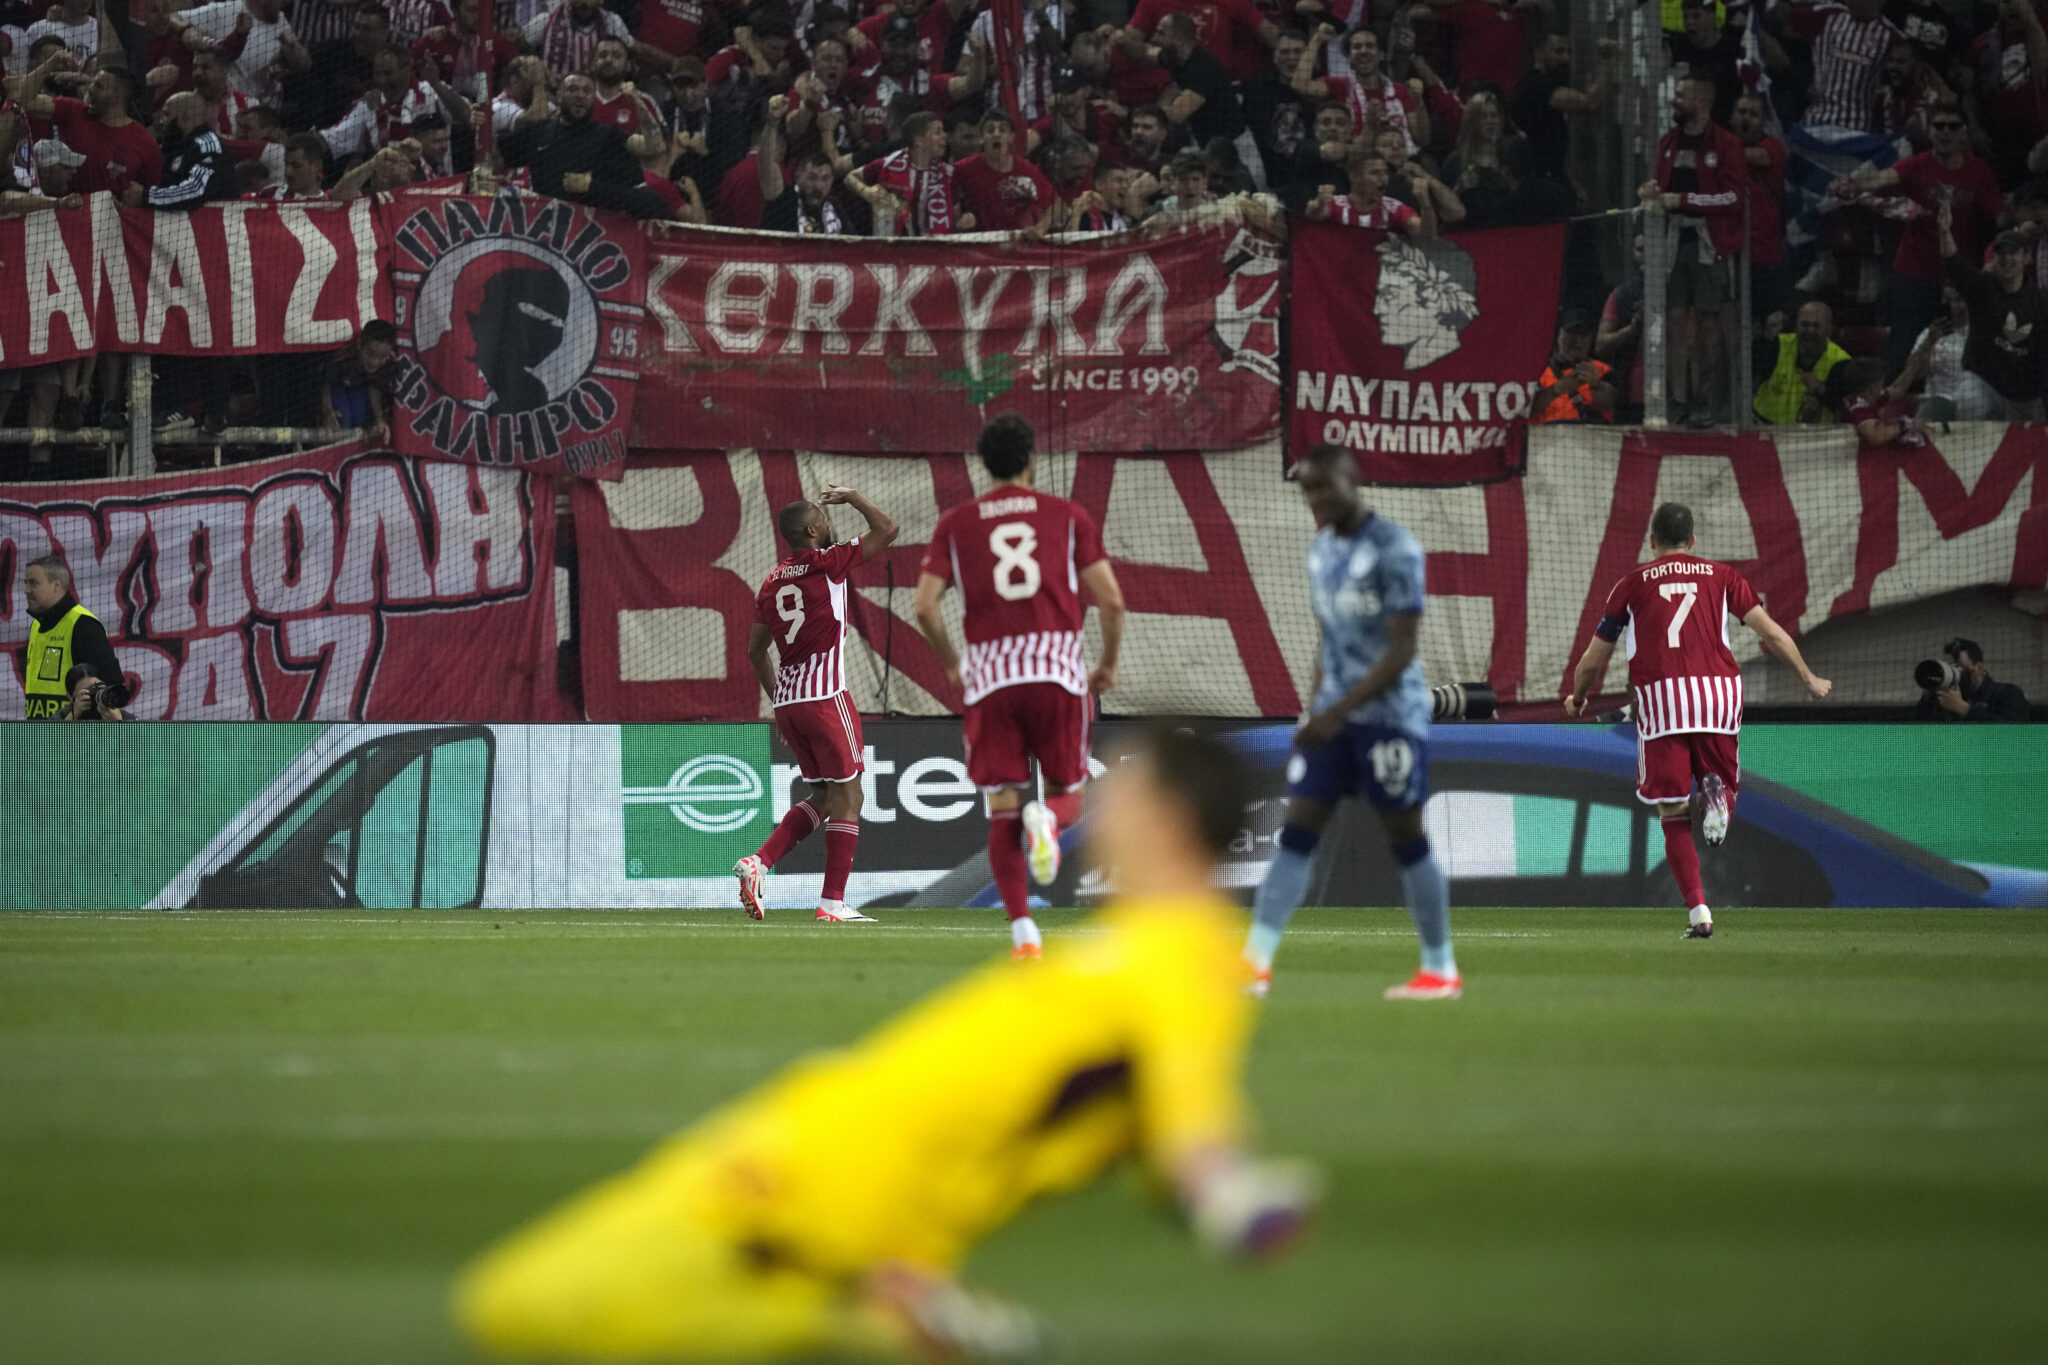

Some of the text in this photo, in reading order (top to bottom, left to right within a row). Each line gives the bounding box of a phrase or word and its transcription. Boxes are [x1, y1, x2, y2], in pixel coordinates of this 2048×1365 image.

[395, 193, 631, 292] ΠΑΛΑΙΟ
[608, 326, 638, 358] 95
[394, 353, 618, 465] ΦΑΛΗΡΟ
[1031, 364, 1125, 392] SINCE
[1128, 365, 1199, 396] 1999
[989, 521, 1041, 600] 8
[1642, 561, 1714, 583] FORTOUNIS
[775, 583, 806, 645] 9
[1658, 582, 1698, 648] 7
[1367, 737, 1413, 796] 19
